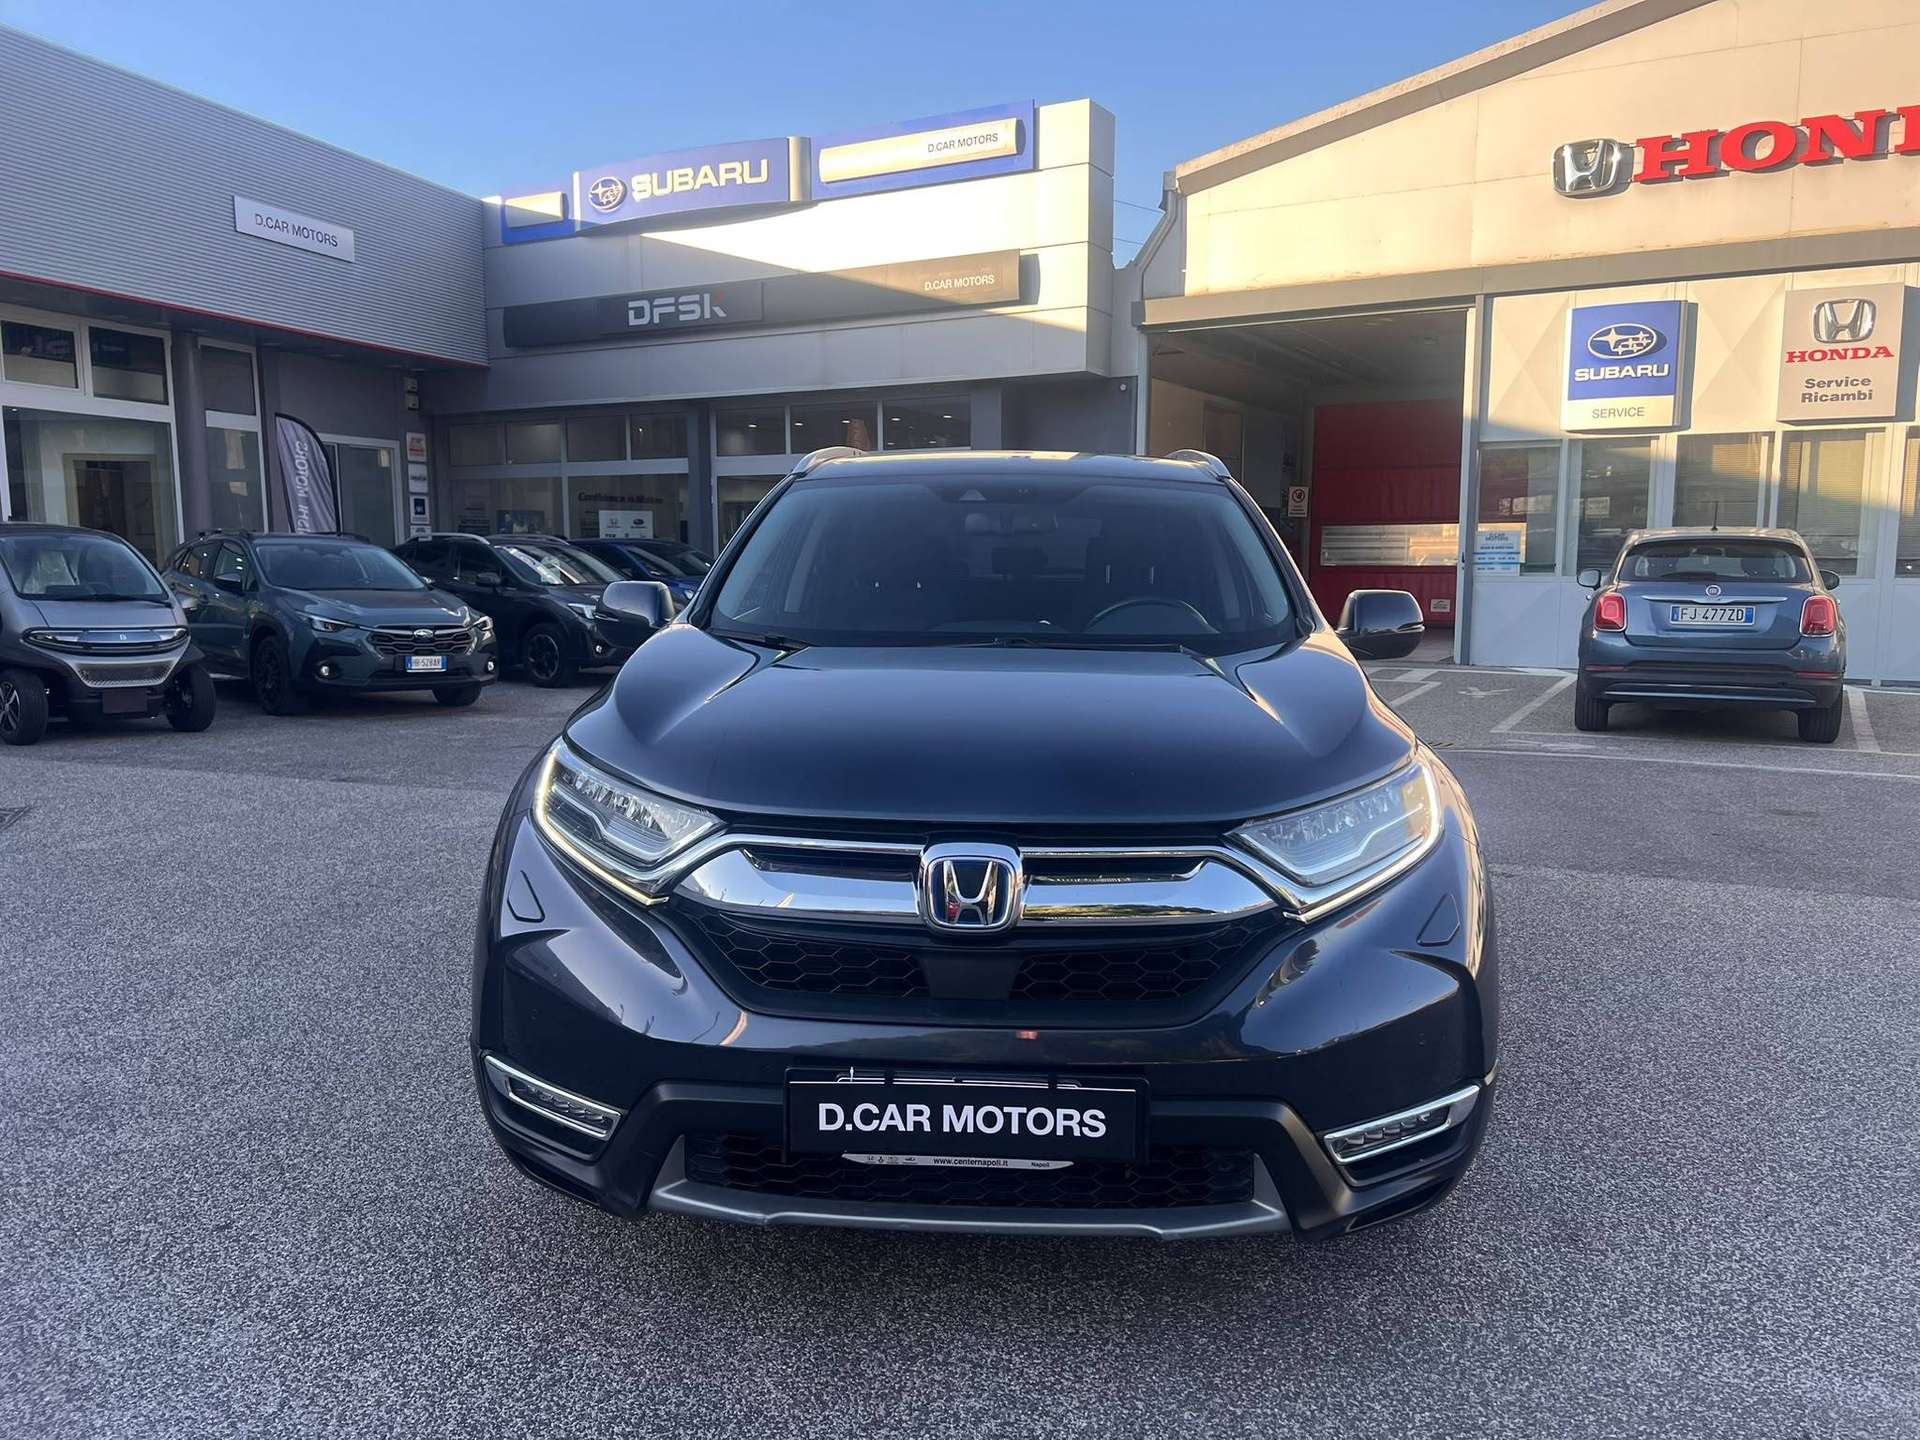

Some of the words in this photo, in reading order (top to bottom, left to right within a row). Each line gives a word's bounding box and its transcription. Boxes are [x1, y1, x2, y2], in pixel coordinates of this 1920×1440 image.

[927, 135, 955, 153] D.CAR
[957, 132, 999, 149] MOTORS
[1632, 105, 1920, 183] HON
[631, 159, 769, 201] SUBARU
[255, 213, 290, 234] D.CAR
[291, 223, 338, 248] MOTORS
[924, 279, 952, 292] D.CAR
[954, 274, 995, 288] MOTORS
[627, 291, 728, 327] DFSK
[1784, 345, 1894, 364] HONDA
[1574, 363, 1669, 382] SUBARU
[1805, 376, 1872, 389] Service
[1801, 389, 1873, 404] Ricambi
[1592, 406, 1645, 419] SERVICE
[1680, 608, 1697, 620] FJ
[1702, 608, 1744, 621] 477ZD
[818, 1103, 931, 1132] D.CAR
[942, 1105, 1106, 1138] MOTORS
[933, 1157, 1008, 1168] www.centernapoli.it
